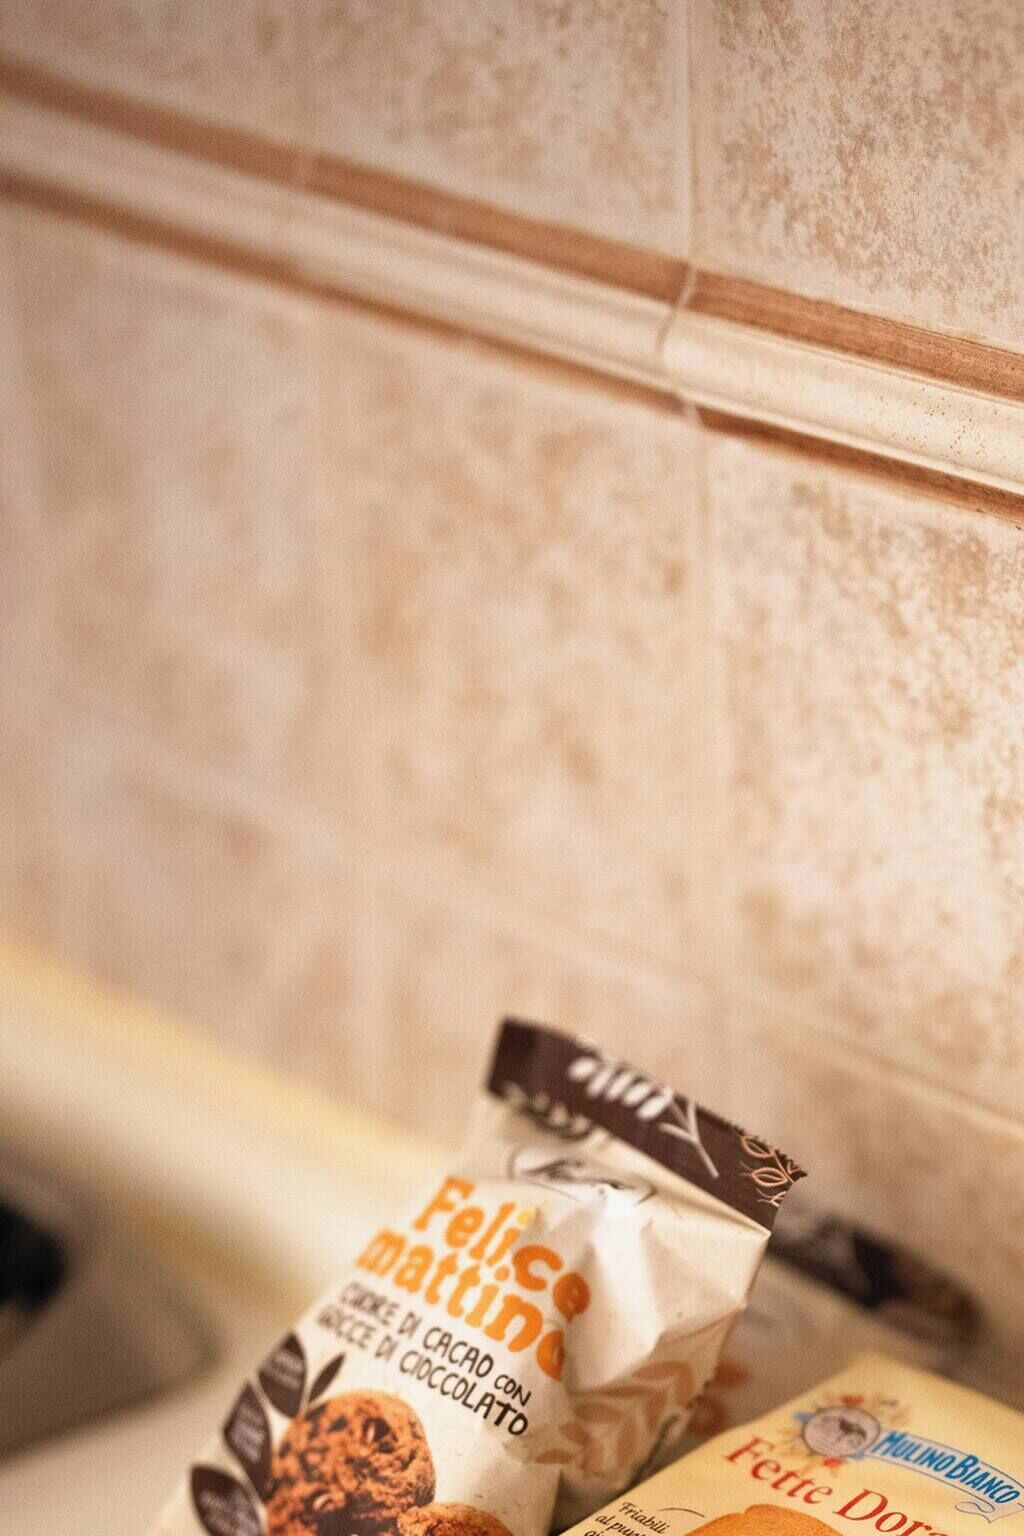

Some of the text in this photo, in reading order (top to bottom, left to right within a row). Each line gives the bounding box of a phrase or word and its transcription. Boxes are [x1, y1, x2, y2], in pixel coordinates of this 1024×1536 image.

[399, 1350, 530, 1437] CIOCCOLATO
[423, 1326, 495, 1379] CACAO
[493, 1373, 532, 1408] CON
[723, 1437, 833, 1505] Fette
[595, 1515, 616, 1526] al
[619, 1501, 671, 1535] Friabili
